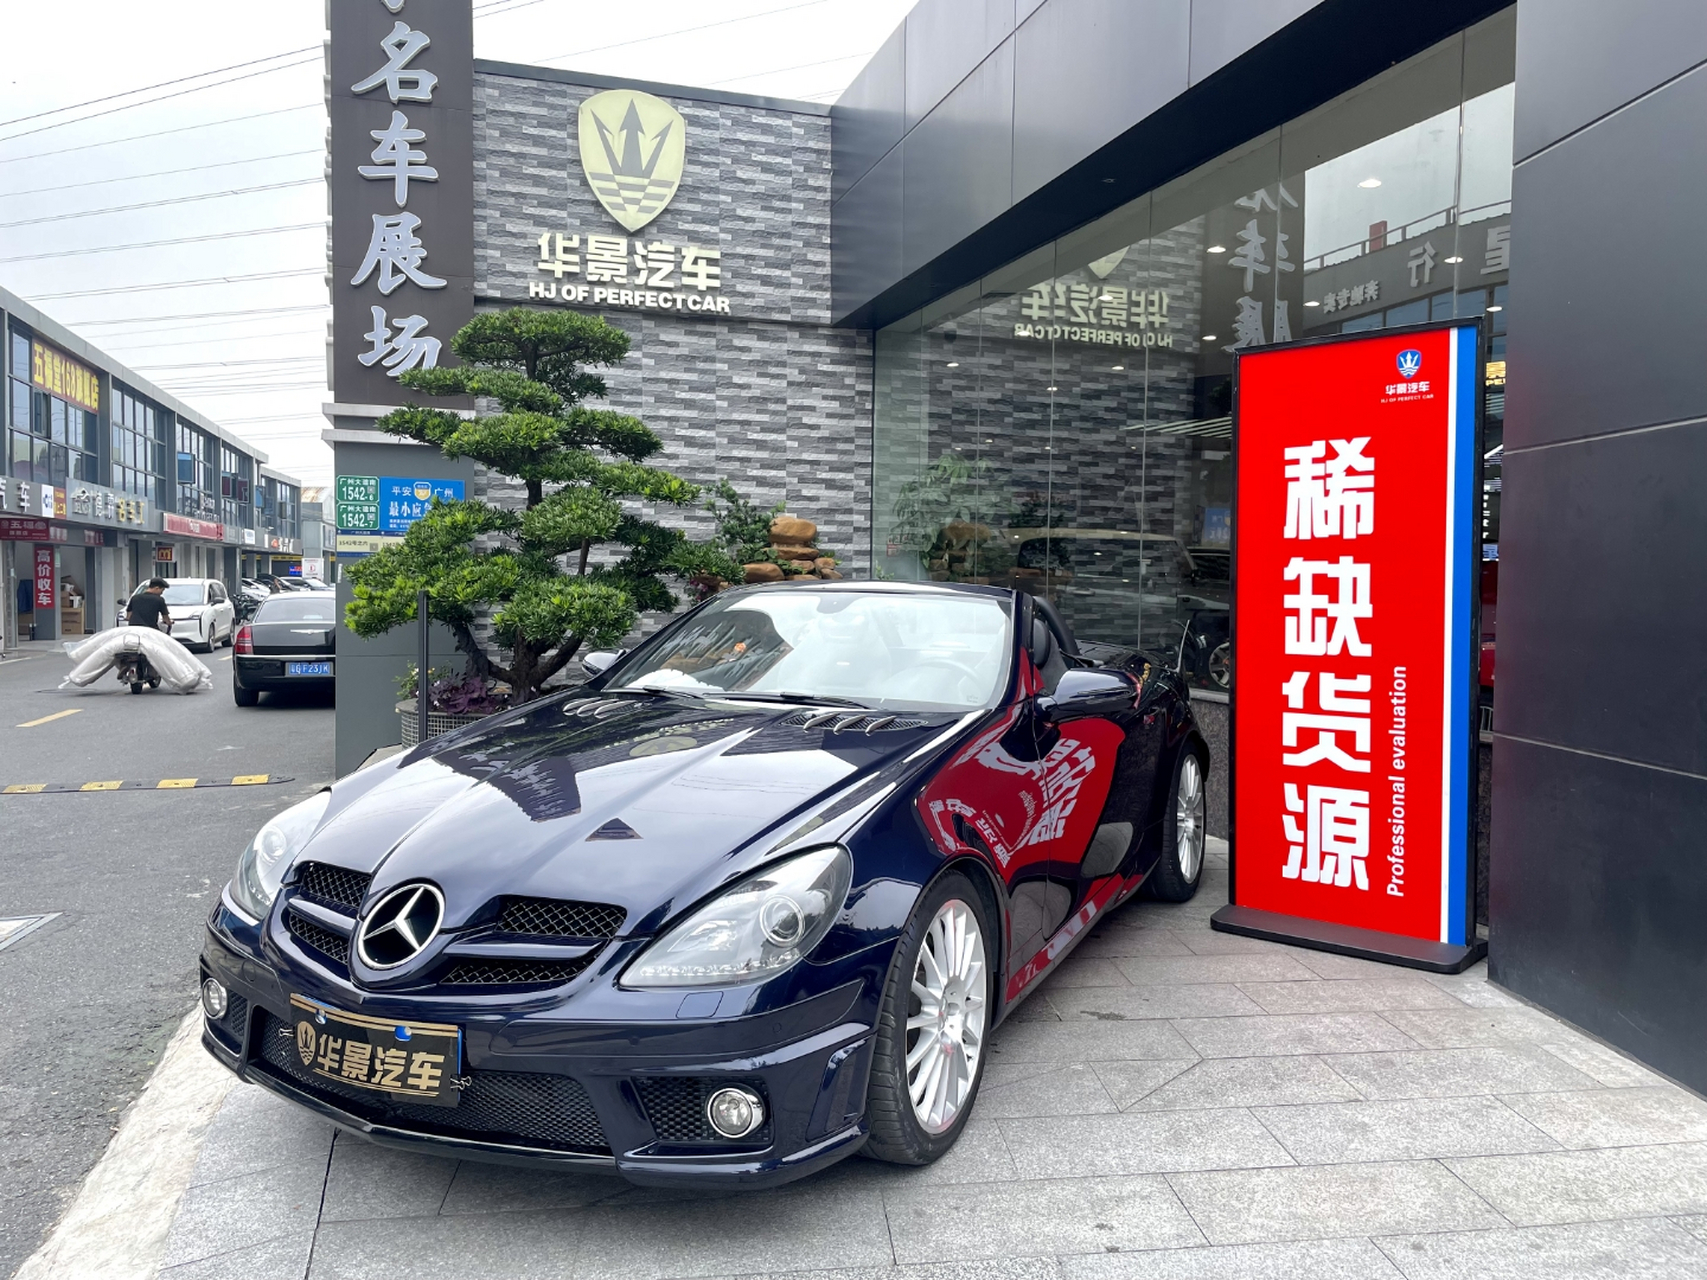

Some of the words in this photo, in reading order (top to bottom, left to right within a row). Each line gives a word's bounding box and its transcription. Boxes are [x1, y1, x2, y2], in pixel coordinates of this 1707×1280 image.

[351, 0, 447, 379] 名车展场
[537, 232, 721, 291] 华景汽车
[529, 282, 556, 299] HJ
[561, 285, 589, 302] OF
[1385, 381, 1430, 395] 华景汽车
[391, 486, 412, 496] 平安
[434, 488, 454, 498] 广州
[37, 549, 52, 606] 高价收车
[1282, 436, 1375, 892] 稀缺货源
[1388, 666, 1407, 770] evaluation
[1387, 776, 1404, 897] Professional
[317, 1033, 445, 1090] 华景汽车
